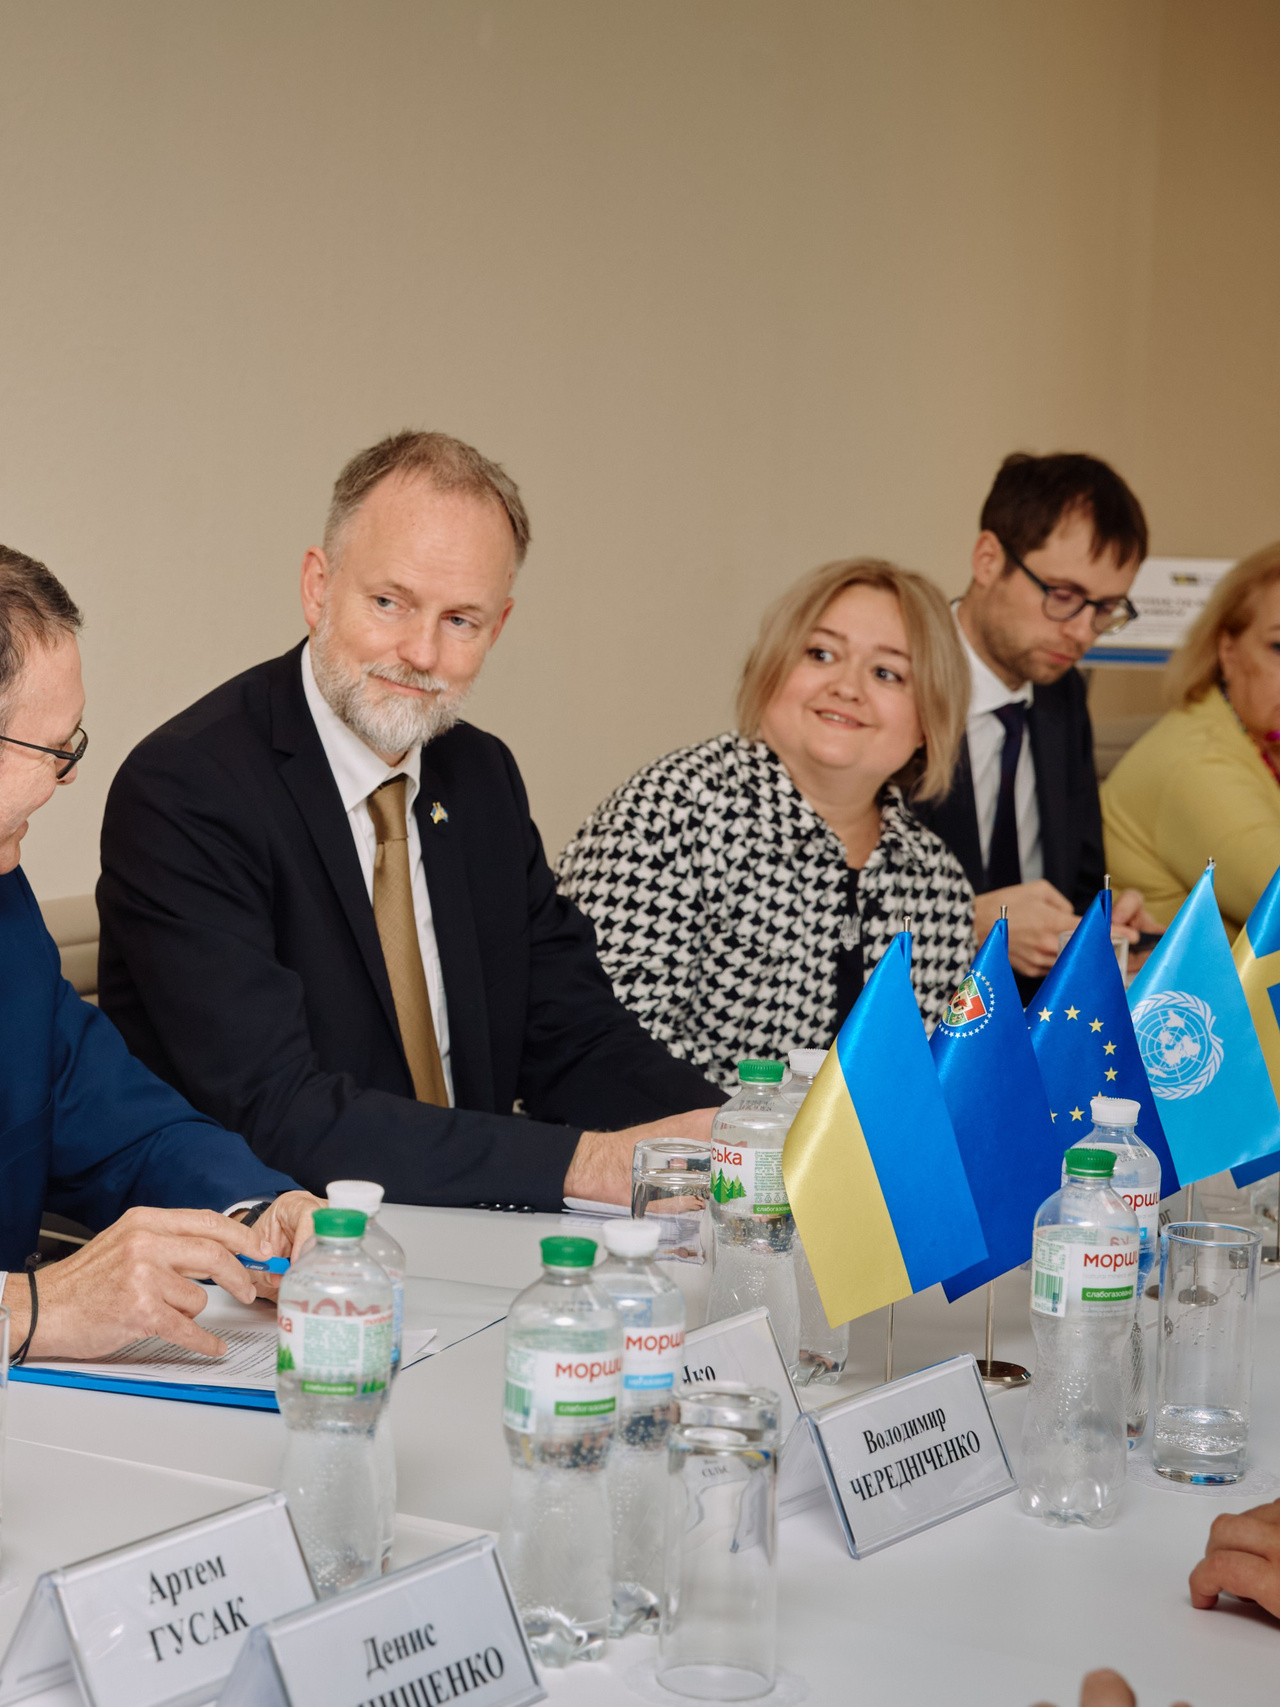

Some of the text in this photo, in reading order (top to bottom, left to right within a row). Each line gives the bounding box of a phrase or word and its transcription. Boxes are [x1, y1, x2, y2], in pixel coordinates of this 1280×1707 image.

[862, 1408, 946, 1454] Володимир
[849, 1430, 980, 1501] ЧЕРЕДНІЧЕНКО
[149, 1555, 226, 1606] Артем
[149, 1596, 250, 1662] ГУСАК
[363, 1623, 437, 1680] Денис
